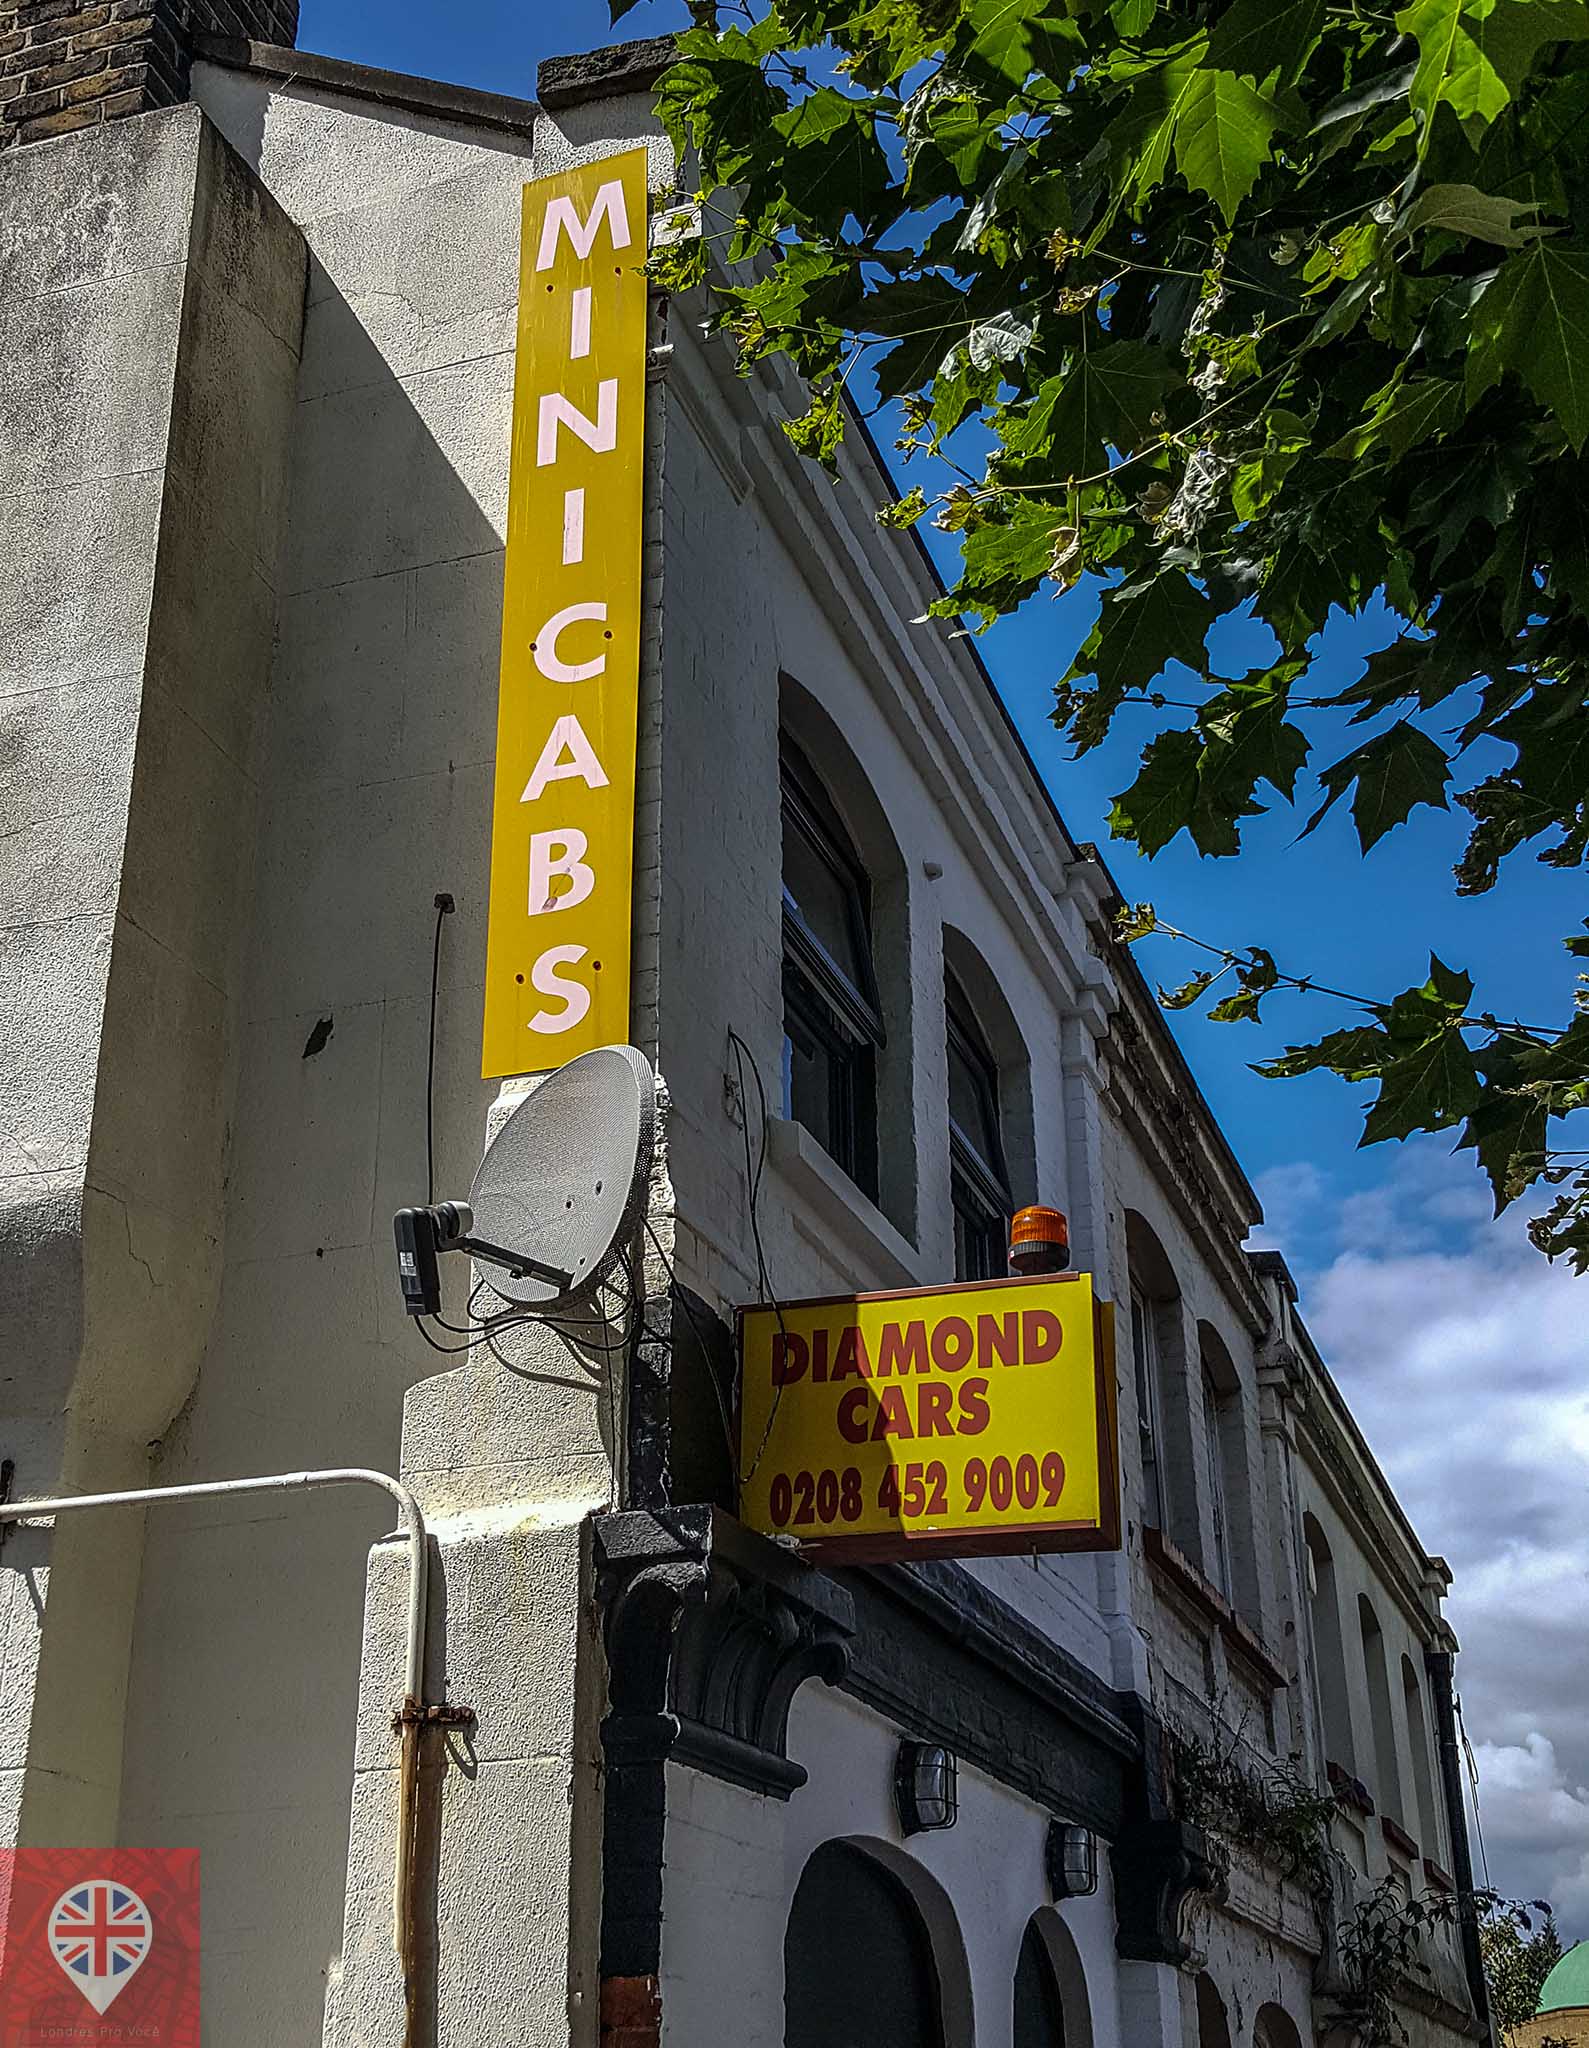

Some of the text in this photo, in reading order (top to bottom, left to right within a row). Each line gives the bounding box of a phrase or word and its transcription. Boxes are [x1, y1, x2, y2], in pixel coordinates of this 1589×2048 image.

[520, 180, 631, 1034] MINICABS
[771, 1310, 1063, 1385] DIAMOND
[837, 1377, 990, 1444] CARS
[769, 1451, 1065, 1528] 0208 452 9009
